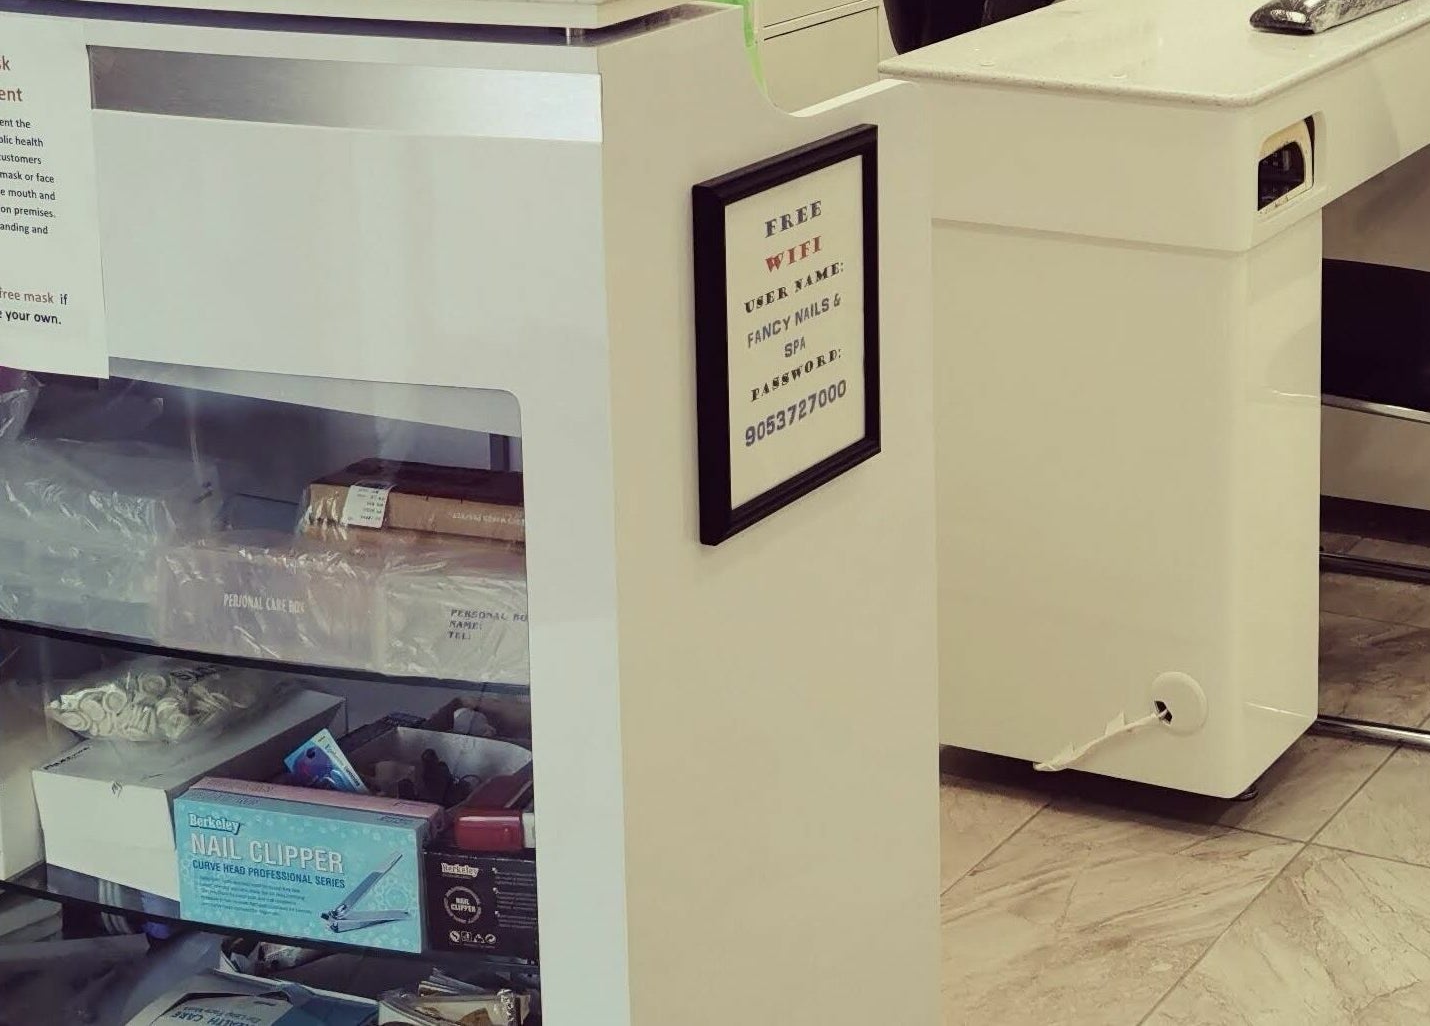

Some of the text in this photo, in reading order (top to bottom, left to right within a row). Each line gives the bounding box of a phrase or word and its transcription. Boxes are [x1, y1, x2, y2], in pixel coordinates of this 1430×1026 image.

[15, 119, 31, 129] the
[15, 136, 43, 147] health
[36, 172, 55, 183] face
[8, 189, 37, 199] mouth
[39, 191, 56, 201] and
[14, 207, 56, 219] premises.
[765, 200, 823, 238] FREE
[32, 225, 48, 234] and
[765, 235, 822, 273] WIFI
[744, 261, 844, 314] USER NAME:
[24, 292, 54, 304] mask
[60, 293, 68, 305] if
[5, 310, 31, 322] your
[33, 314, 62, 325] own.
[747, 292, 841, 348] FANCY NAILS &
[784, 336, 807, 359] SPA
[750, 348, 842, 403] PASSWORD:
[745, 379, 847, 448] 9053727000
[224, 592, 263, 610] PERSONAL
[265, 596, 287, 612] CARE
[451, 608, 528, 622] PERSONAL BO
[189, 813, 240, 834] Berkeley
[191, 833, 344, 874] NAIL CLIPPER
[192, 859, 345, 888] CURVE HEAD PROFESSIONAL SERIES
[441, 862, 479, 877] Berkeley
[450, 903, 476, 913] CLIPPER
[455, 897, 470, 905] NAIL
